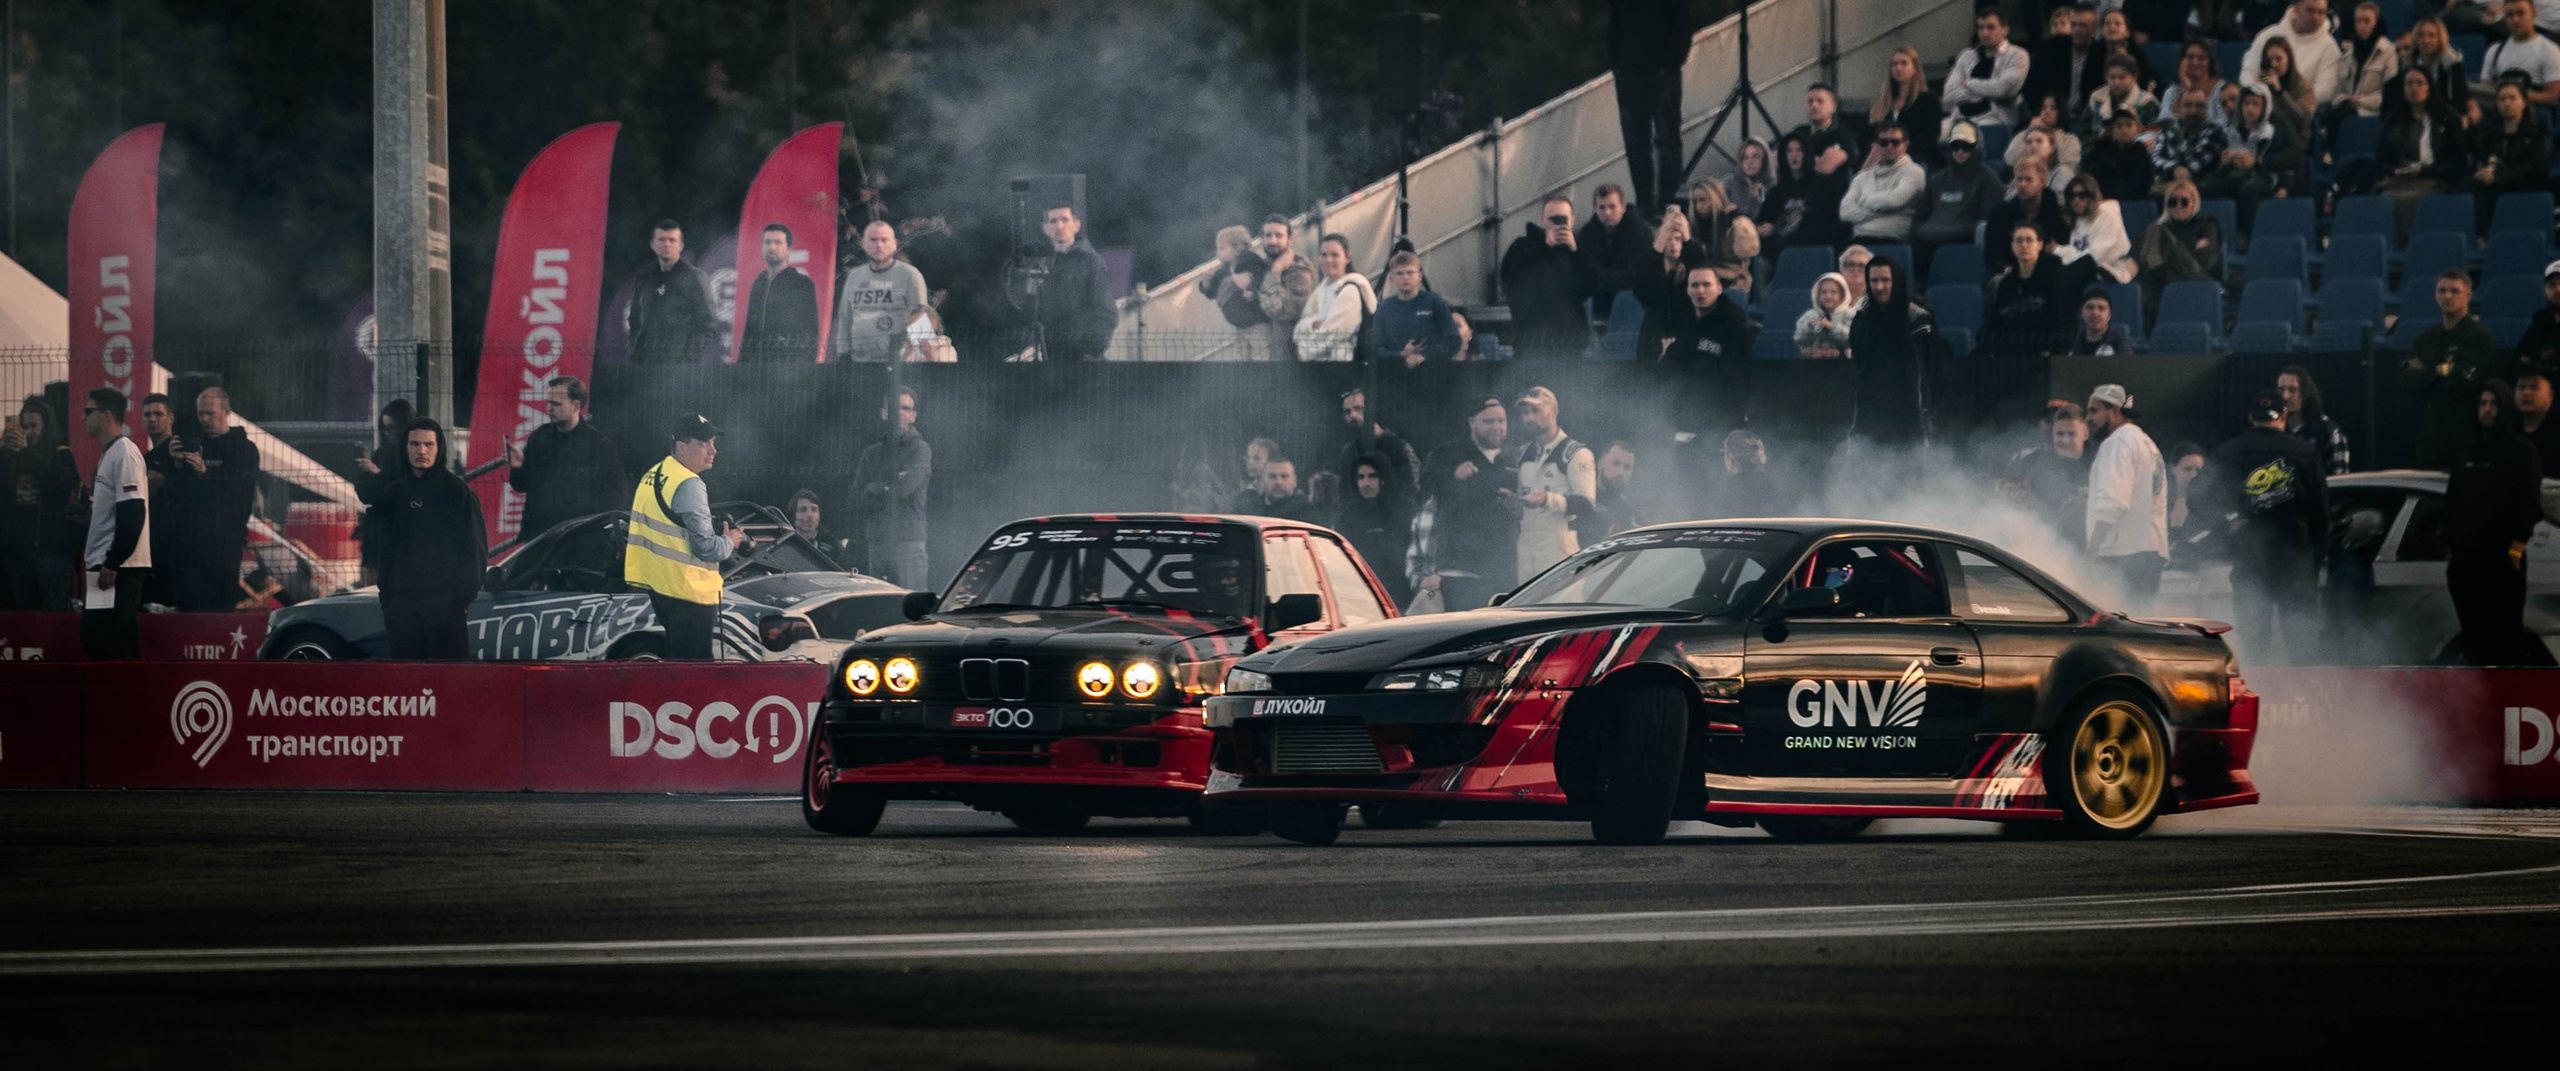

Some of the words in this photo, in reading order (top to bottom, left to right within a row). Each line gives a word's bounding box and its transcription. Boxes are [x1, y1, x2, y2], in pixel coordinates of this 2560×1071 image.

[853, 290, 893, 304] USPA
[988, 531, 1034, 551] 95
[246, 687, 437, 717] Московский
[1264, 696, 1326, 715] ЛУКОЙЛ
[1787, 679, 1896, 728] GNV
[985, 707, 1034, 728] 100
[1784, 736, 1833, 749] GRAND
[1836, 736, 1868, 749] NEW
[1871, 735, 1917, 750] VISION
[2504, 706, 2560, 766] D
[246, 734, 404, 763] транспорт
